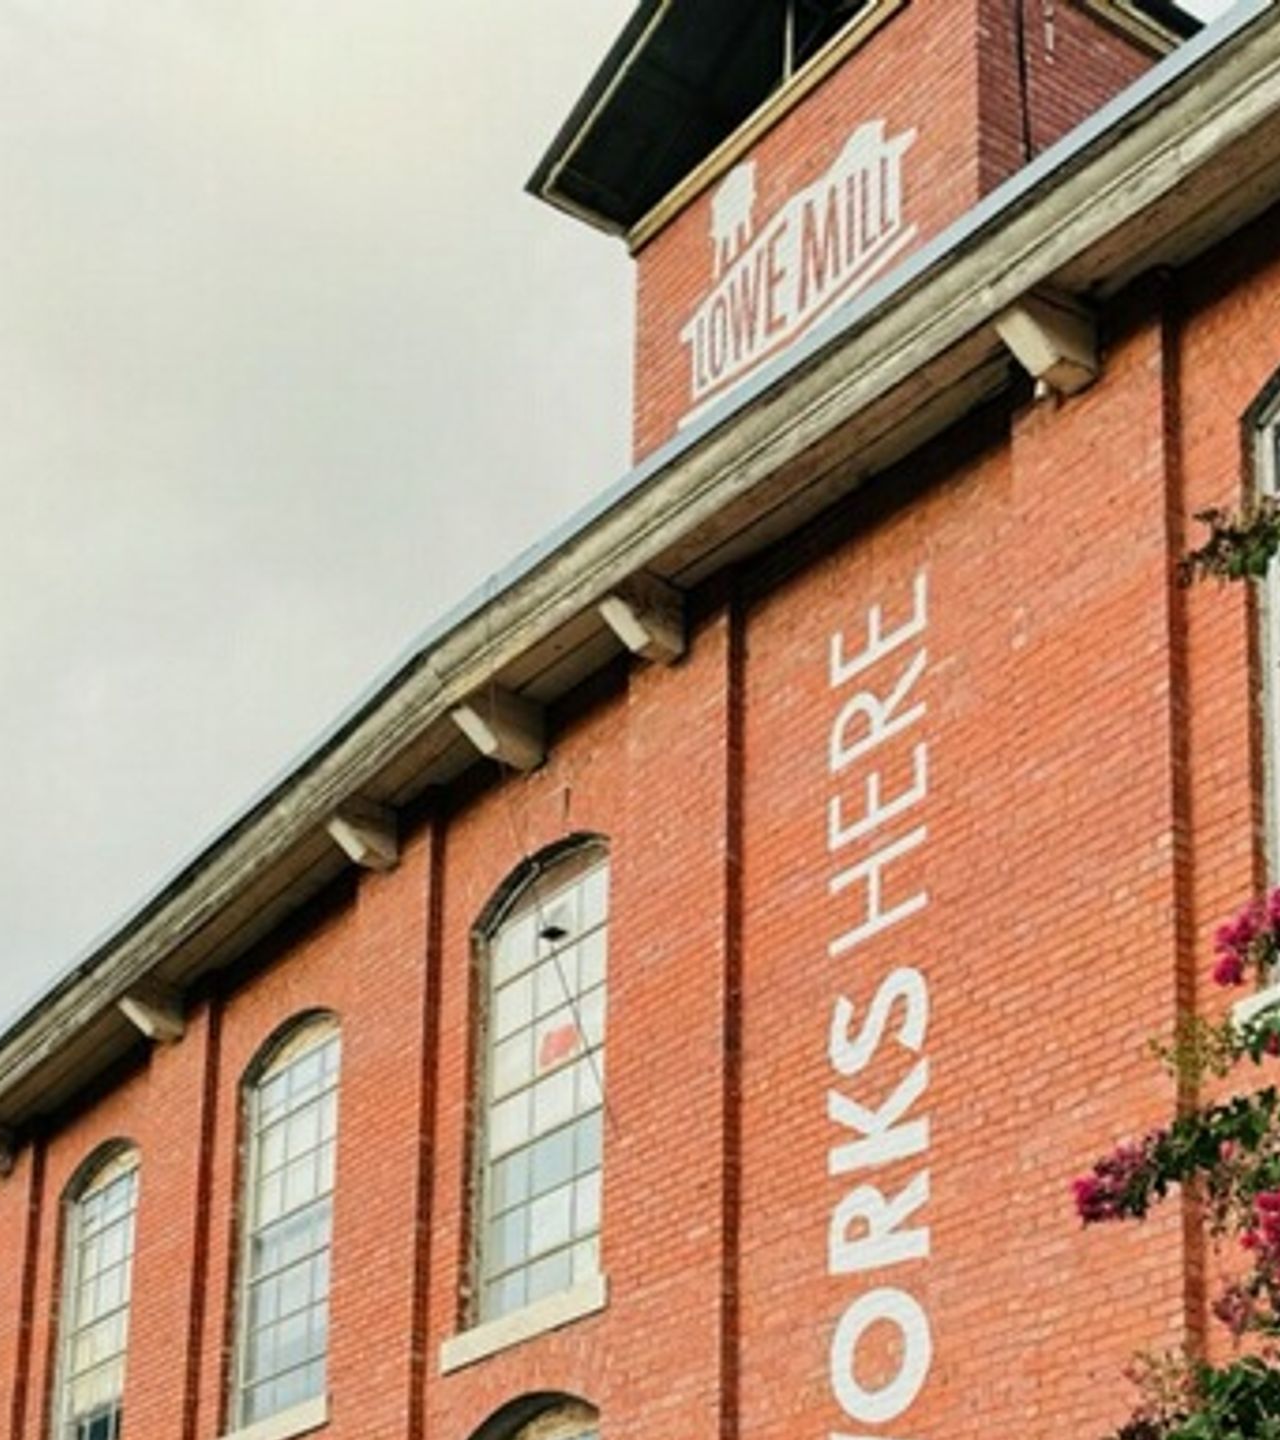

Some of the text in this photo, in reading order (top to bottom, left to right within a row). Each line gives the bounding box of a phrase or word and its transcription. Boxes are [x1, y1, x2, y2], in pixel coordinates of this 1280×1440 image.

[695, 154, 896, 391] LOWE MILL
[827, 573, 928, 956] HERE
